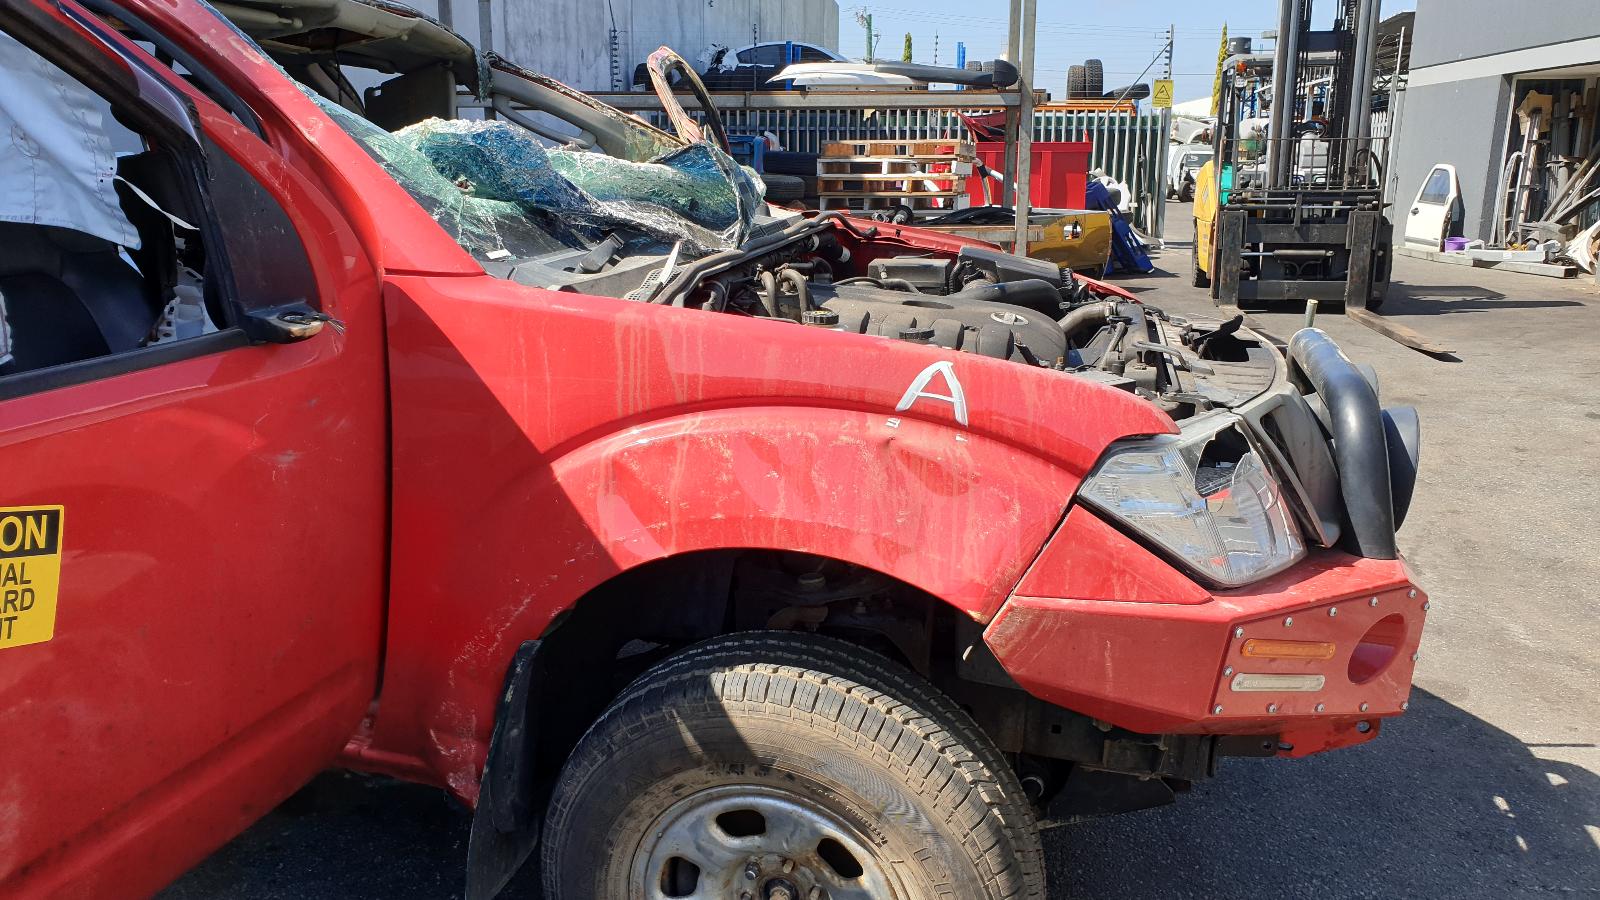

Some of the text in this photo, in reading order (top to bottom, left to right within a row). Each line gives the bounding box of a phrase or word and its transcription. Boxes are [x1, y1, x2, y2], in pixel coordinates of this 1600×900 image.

[894, 360, 969, 429] A
[0, 514, 48, 552] ON
[0, 588, 35, 614] RD
